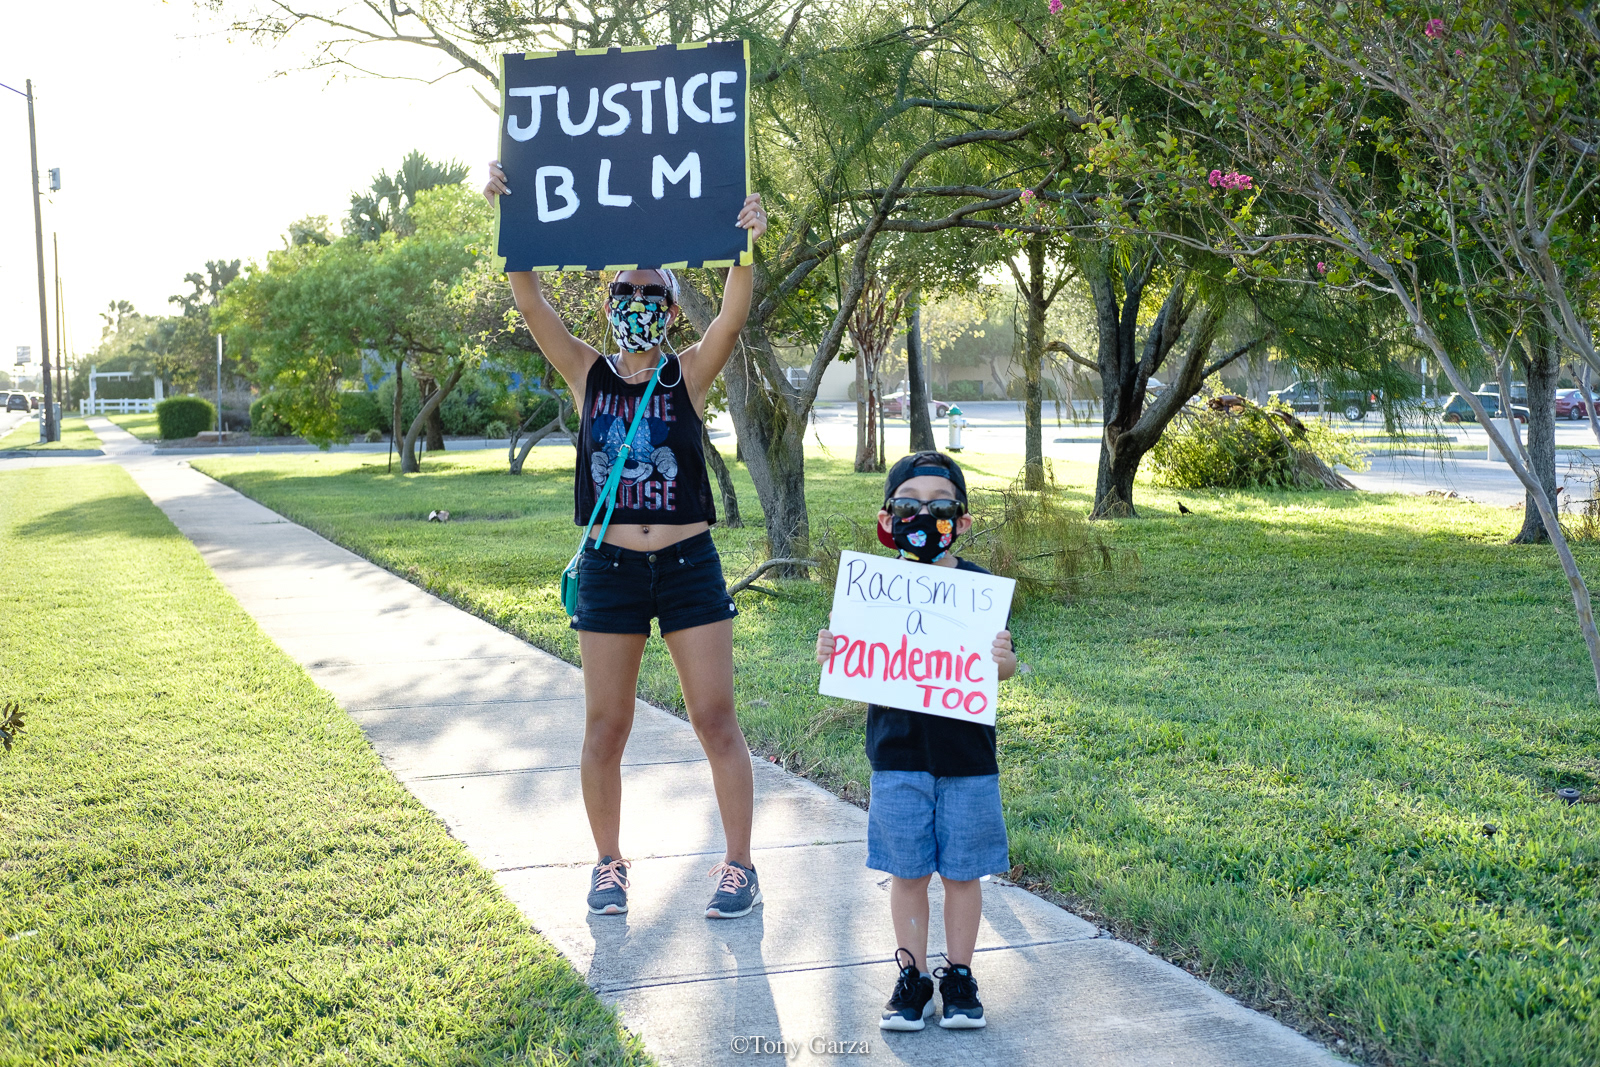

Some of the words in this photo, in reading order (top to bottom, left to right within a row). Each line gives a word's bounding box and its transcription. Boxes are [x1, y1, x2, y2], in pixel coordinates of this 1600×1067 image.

[507, 70, 738, 142] JUSTICE
[847, 559, 957, 608] Racism
[971, 579, 993, 612] is
[906, 609, 927, 635] a
[828, 634, 985, 683] Pandemic
[916, 684, 988, 715] TOO
